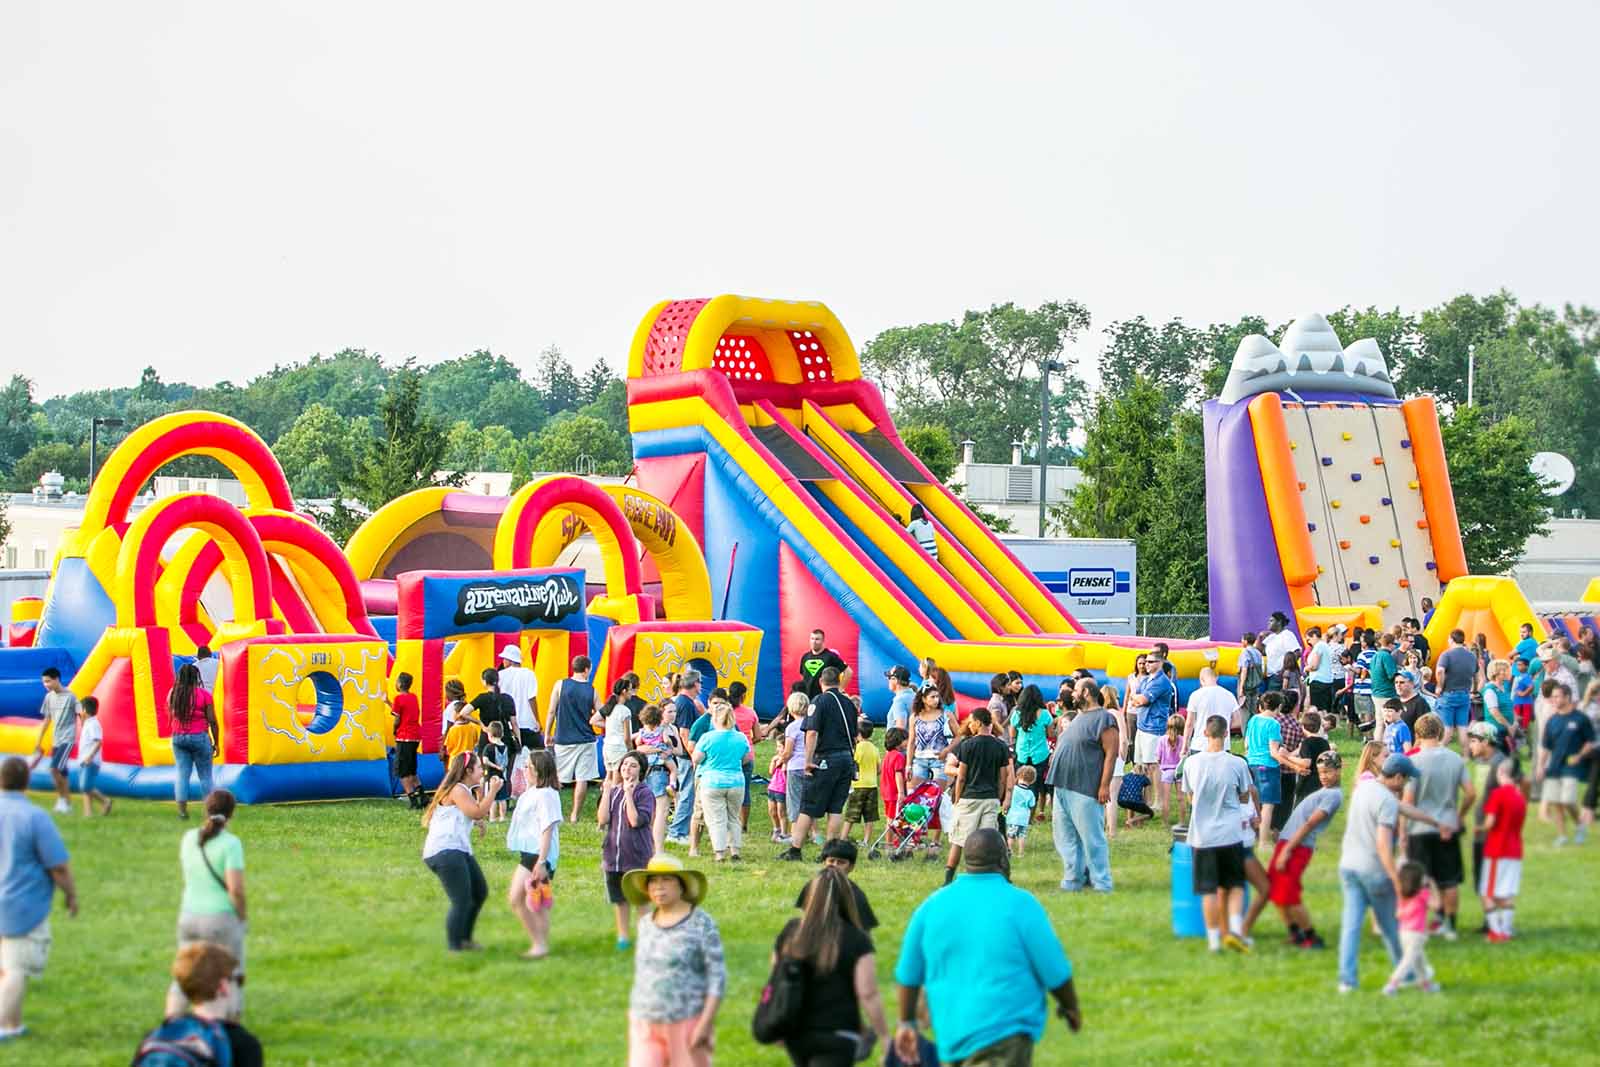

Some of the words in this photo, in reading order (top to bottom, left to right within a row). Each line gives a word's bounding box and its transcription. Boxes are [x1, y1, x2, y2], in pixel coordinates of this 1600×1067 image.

[1072, 576, 1112, 587] PENSKE
[545, 577, 578, 616] Rush
[1078, 598, 1090, 606] Truck
[1091, 598, 1107, 606] Rental
